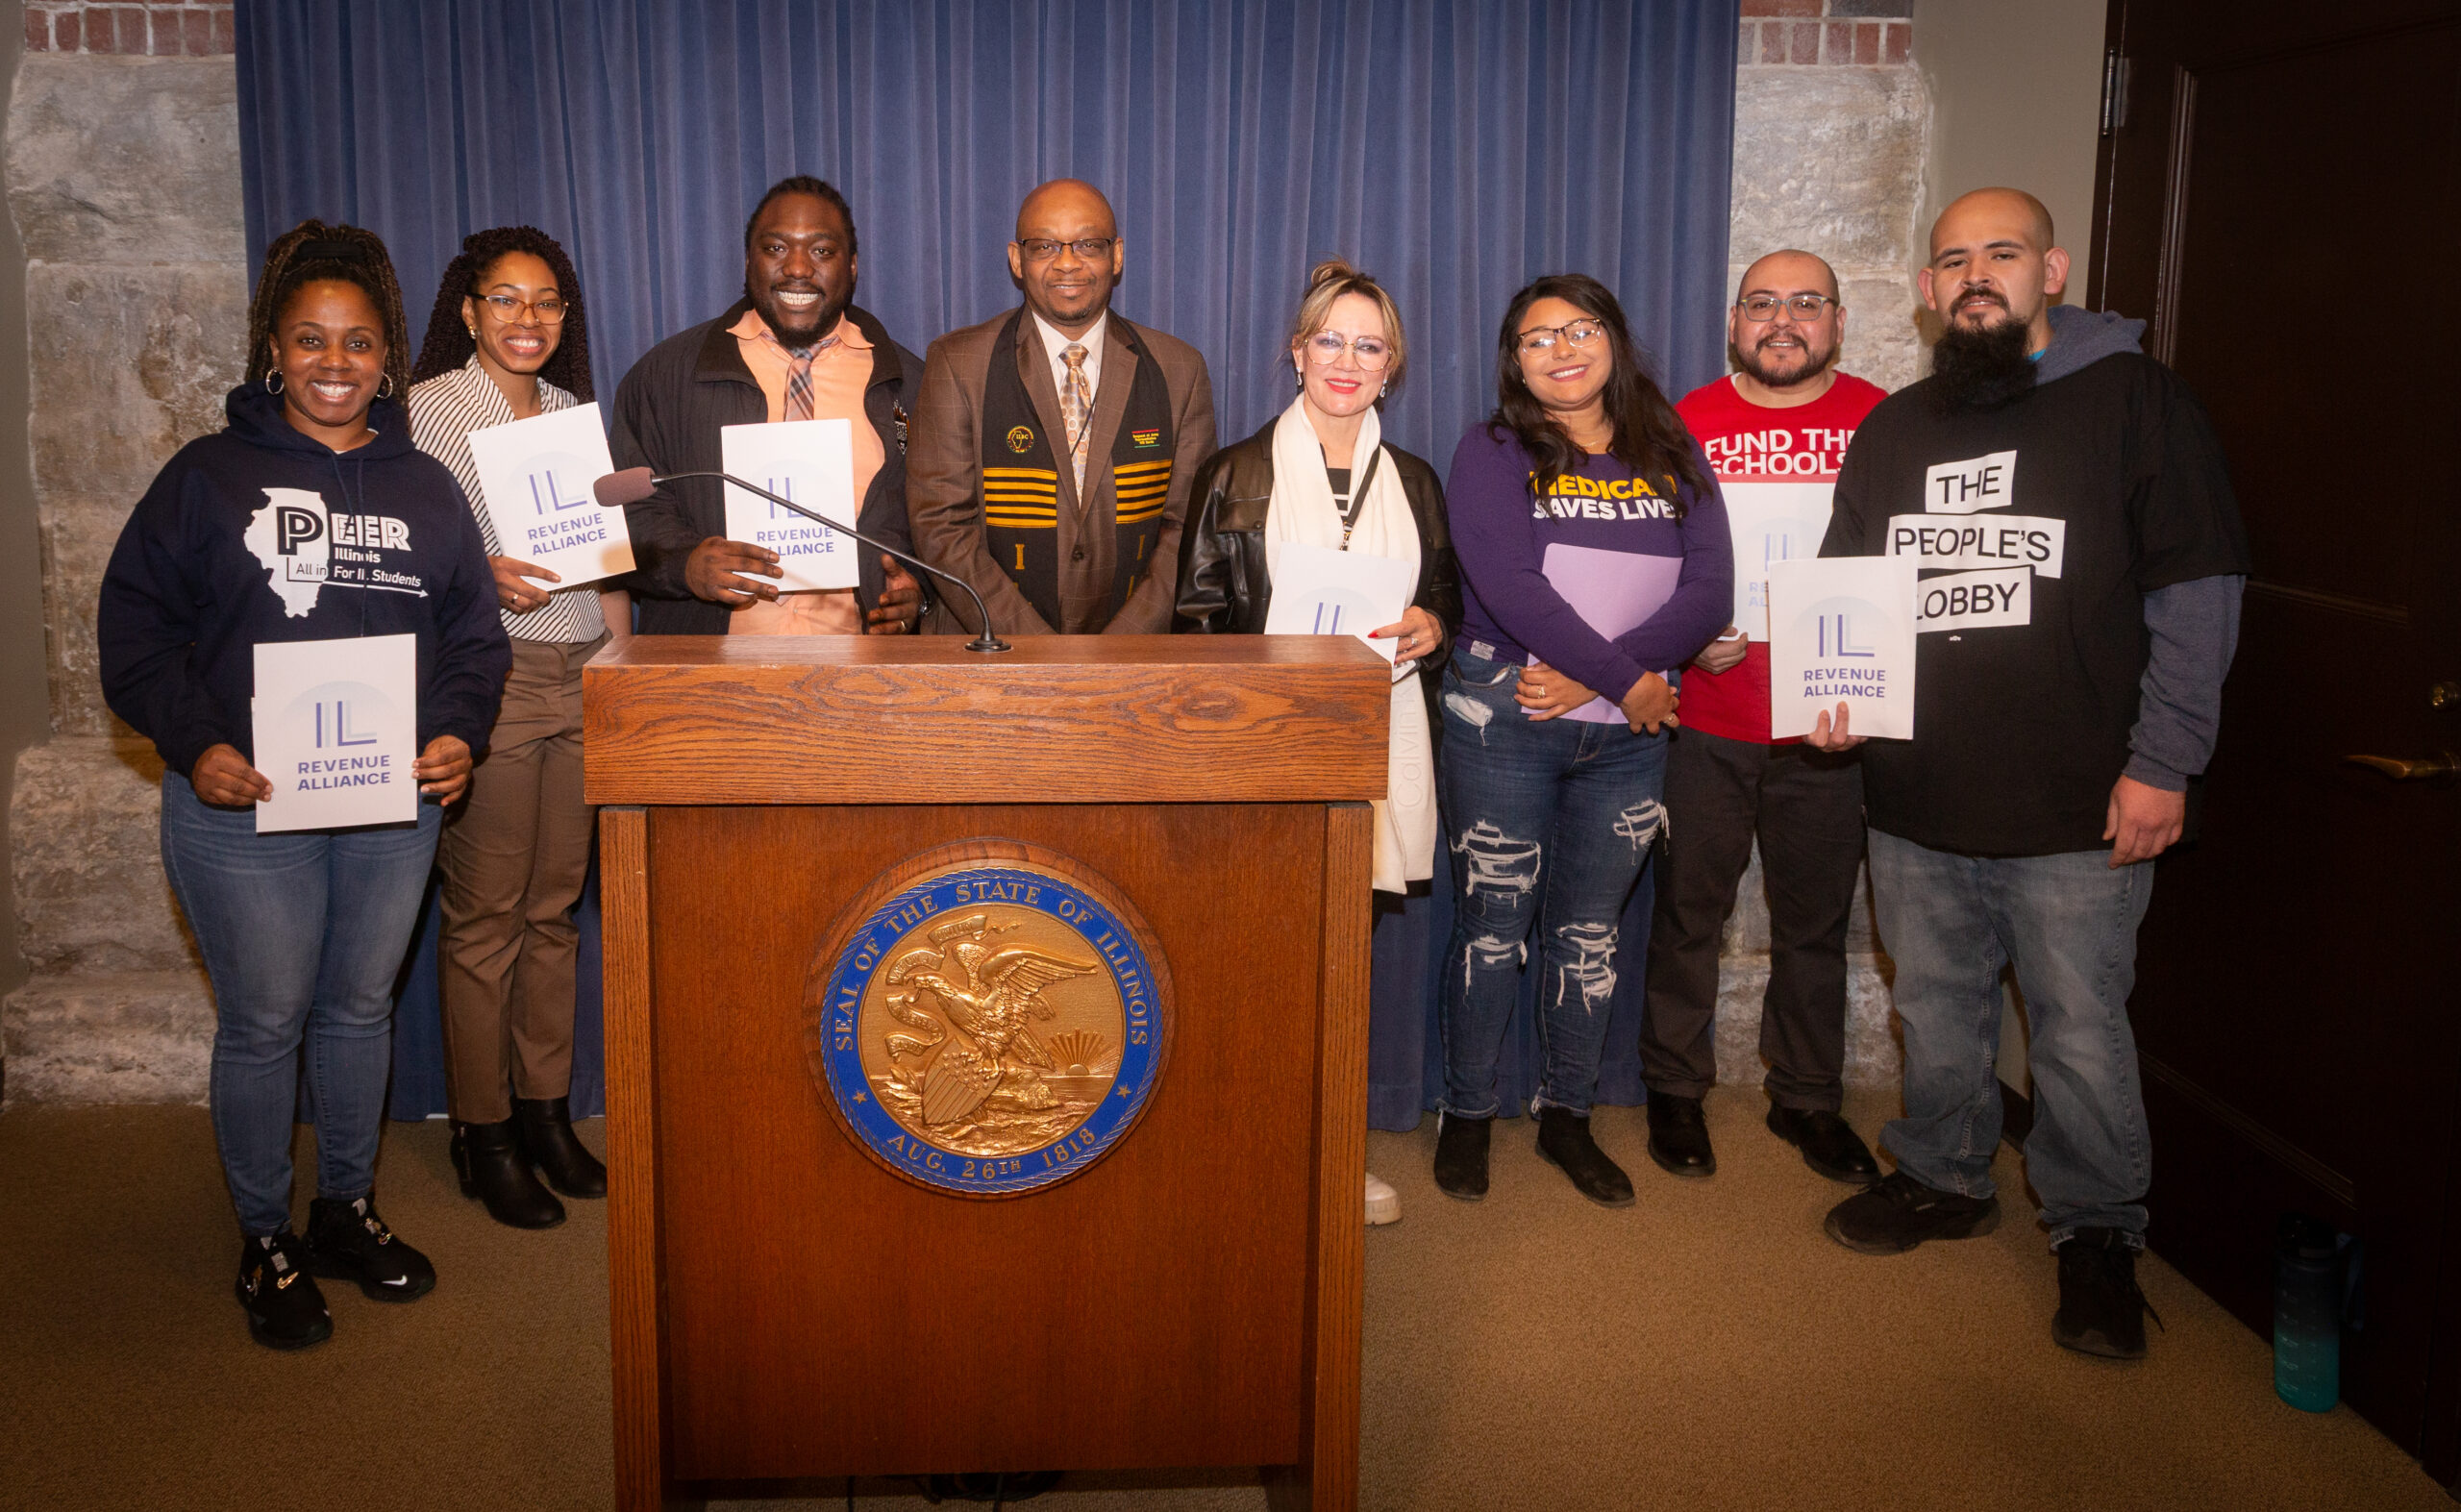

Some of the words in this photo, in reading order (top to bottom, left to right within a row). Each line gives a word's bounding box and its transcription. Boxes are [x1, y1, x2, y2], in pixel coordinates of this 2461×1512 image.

[1704, 429, 1793, 460] FUND
[1936, 465, 2002, 504] THE
[1532, 498, 1617, 520] SAVES
[1619, 498, 1682, 520] LIVE
[527, 512, 604, 540] REVENUE
[757, 527, 833, 542] REVENUE
[532, 528, 608, 556] ALLIANCE
[768, 541, 834, 557] LIANCE
[1895, 527, 2051, 562] PEOPLE'S
[335, 547, 382, 563] Illinois
[296, 563, 312, 575] All
[316, 564, 327, 575] in
[334, 565, 355, 579] For
[372, 569, 422, 587] Students
[1917, 582, 2021, 620] OBBY
[1803, 668, 1886, 682] REVENUE
[1803, 683, 1886, 698] ALLIANCE
[298, 755, 390, 775] REVENUE
[297, 772, 391, 791] ALLIANCE
[835, 983, 861, 1051] SEAL
[855, 938, 882, 973] OF
[883, 895, 939, 934] THE
[956, 881, 1041, 905] STATE
[1057, 900, 1095, 930] OF
[1096, 932, 1148, 1047] ILLINOIS
[887, 1135, 947, 1172] AUG.
[1042, 1128, 1096, 1168] 1818
